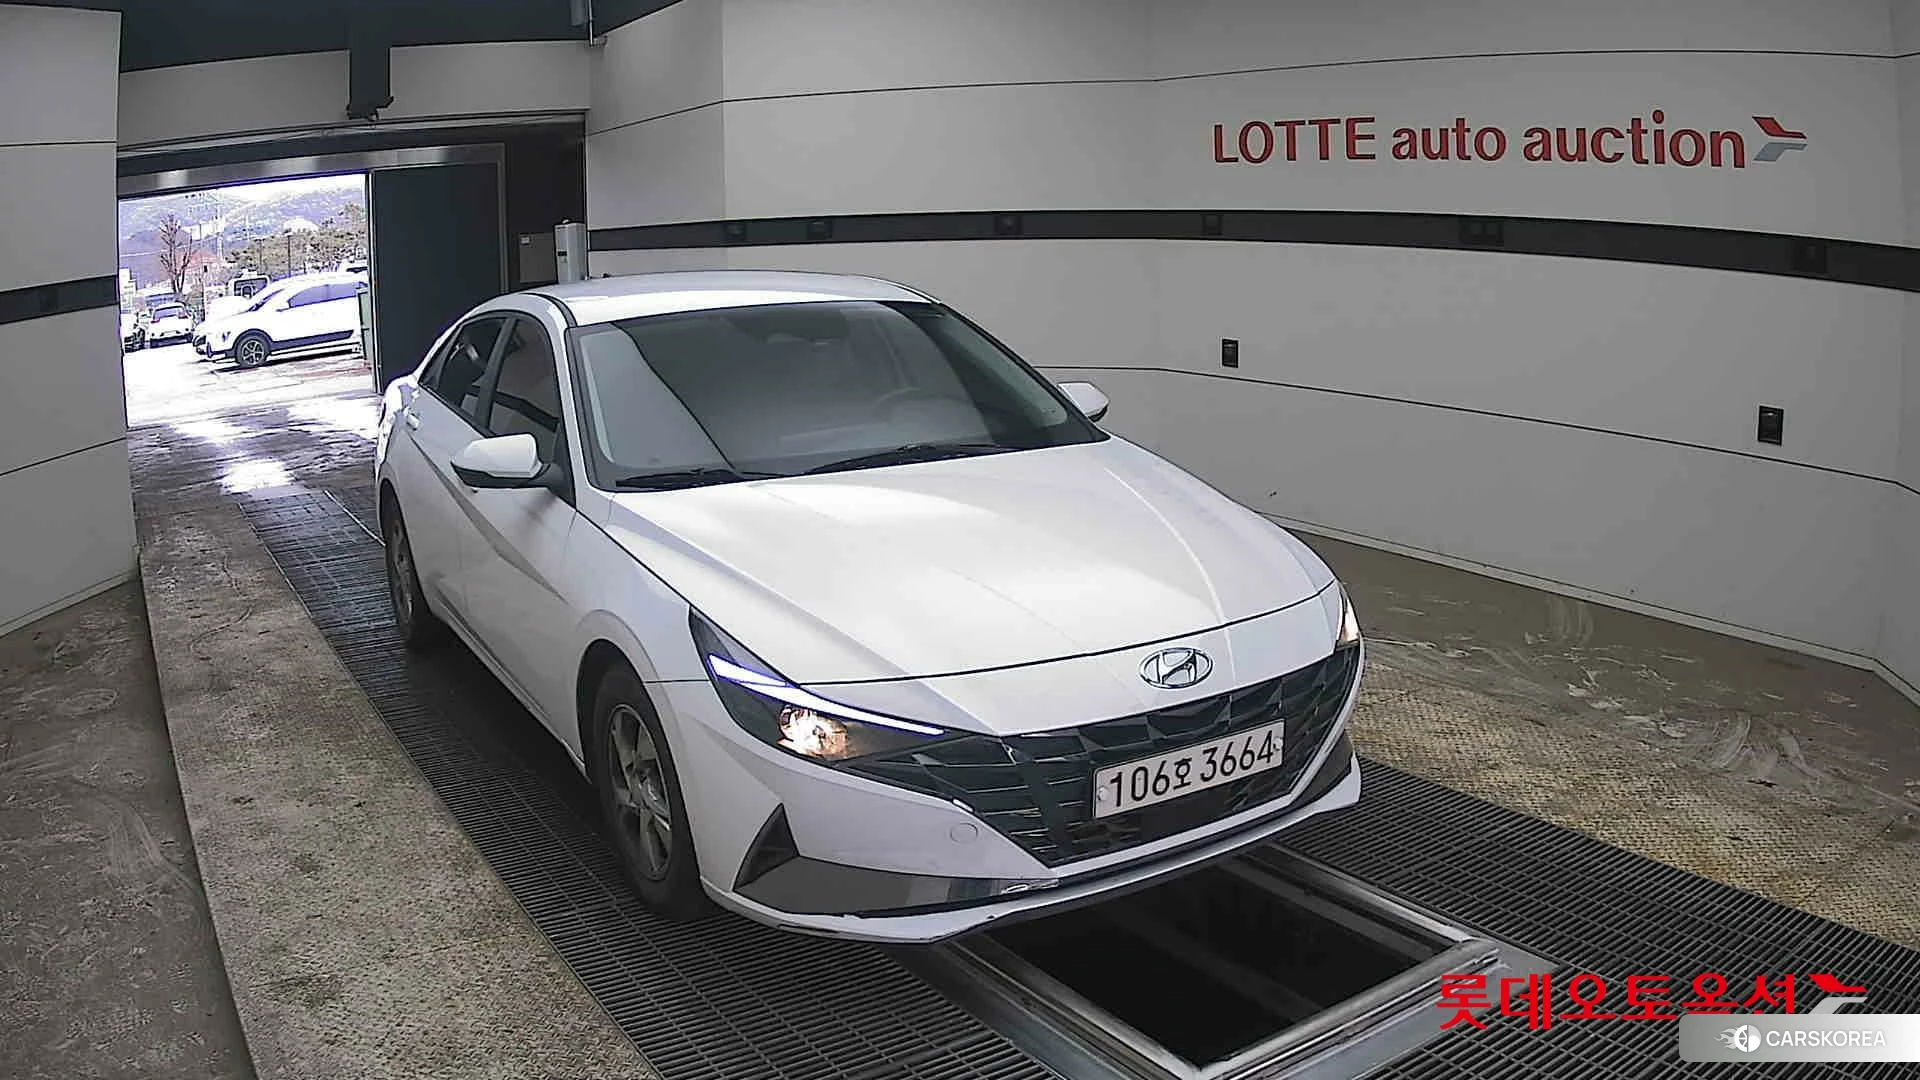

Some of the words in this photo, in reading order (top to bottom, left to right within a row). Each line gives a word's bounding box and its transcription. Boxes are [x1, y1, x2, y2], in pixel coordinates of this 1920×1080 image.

[1213, 116, 1377, 163] LOTTE
[1391, 117, 1508, 161] auto
[1522, 109, 1746, 168] auction
